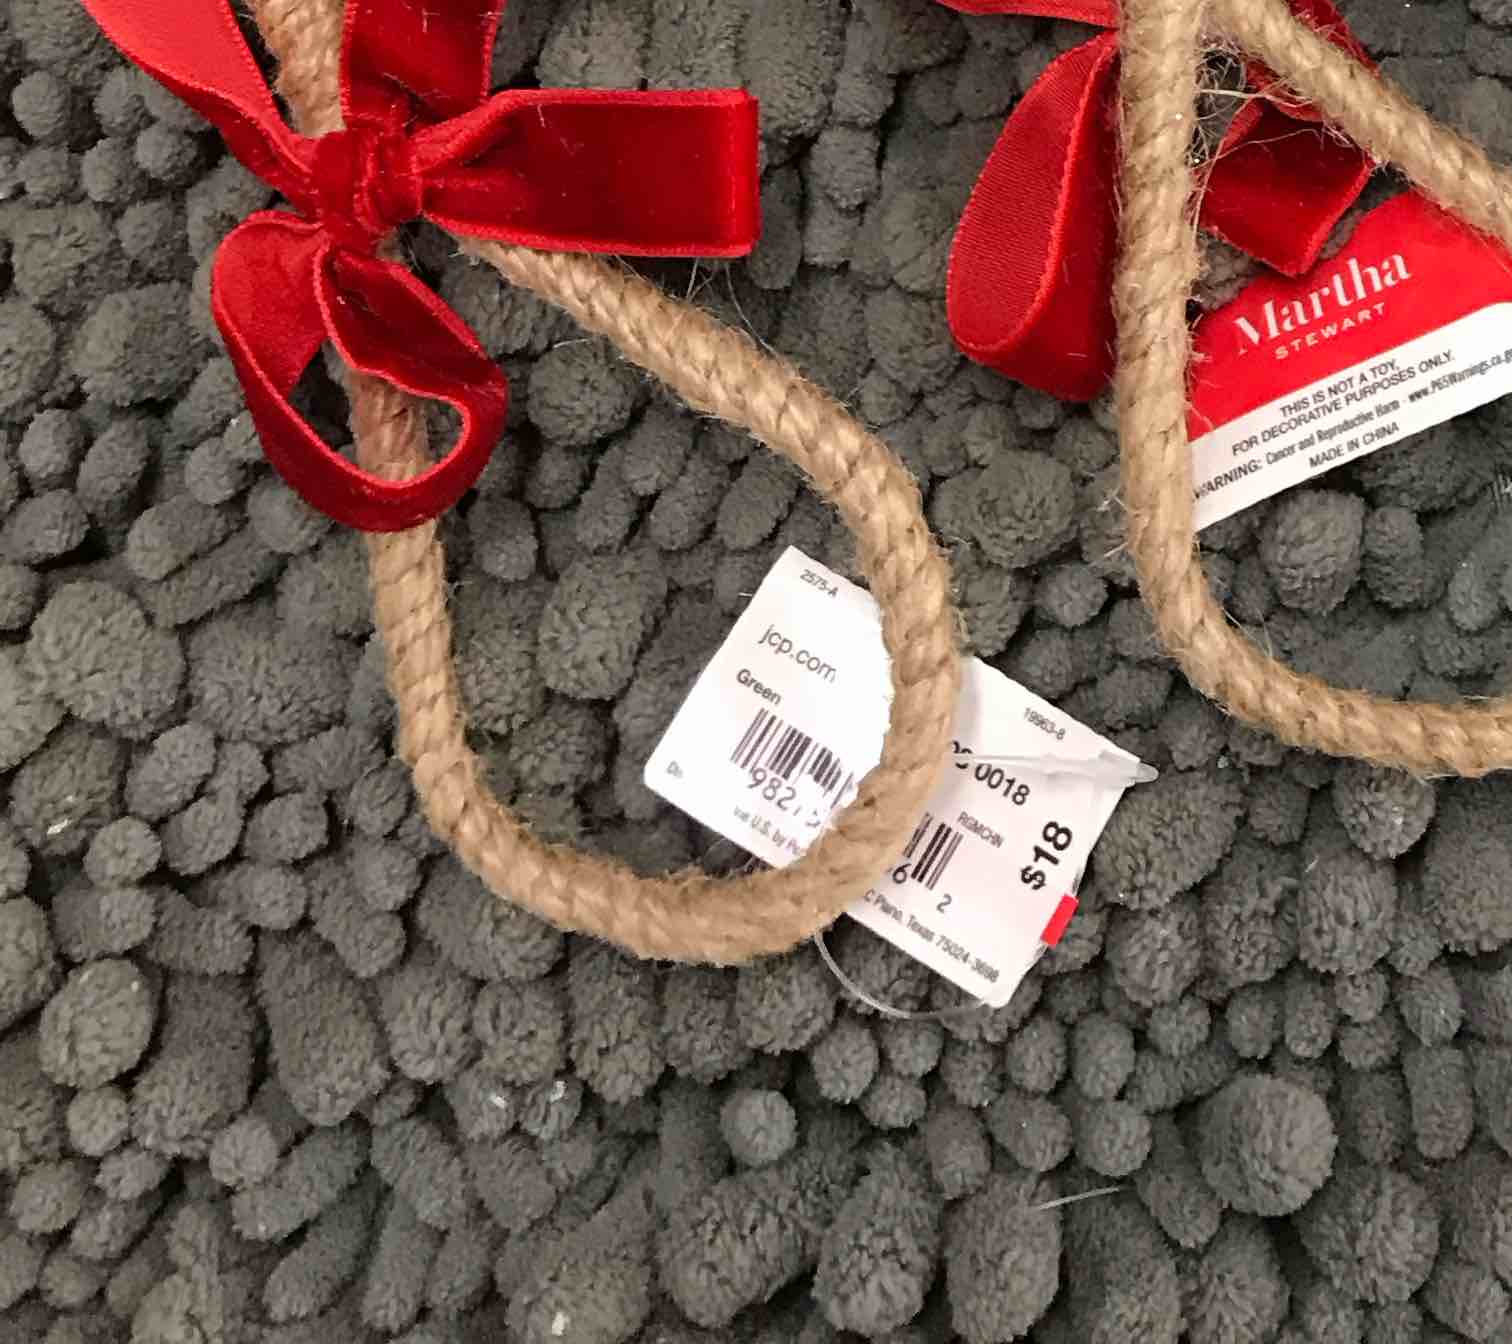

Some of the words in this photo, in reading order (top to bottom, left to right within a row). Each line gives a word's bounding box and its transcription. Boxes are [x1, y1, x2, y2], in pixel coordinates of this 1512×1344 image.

[1231, 250, 1412, 355] Martha
[1274, 301, 1385, 360] STEWART
[1231, 435, 1259, 456] FOR
[1261, 398, 1342, 442] DECORATIVE
[1344, 366, 1416, 406] PURPOSES
[1280, 397, 1310, 418] THIS
[1327, 376, 1354, 398] NOT
[1297, 434, 1315, 451] and
[1316, 410, 1374, 443] Reproductive
[1374, 399, 1400, 417] Harm
[1309, 445, 1344, 468] MADE
[1362, 421, 1399, 445] CHINA
[757, 623, 838, 684] jcp.com
[735, 668, 782, 705] Green
[1019, 820, 1073, 891] $18
